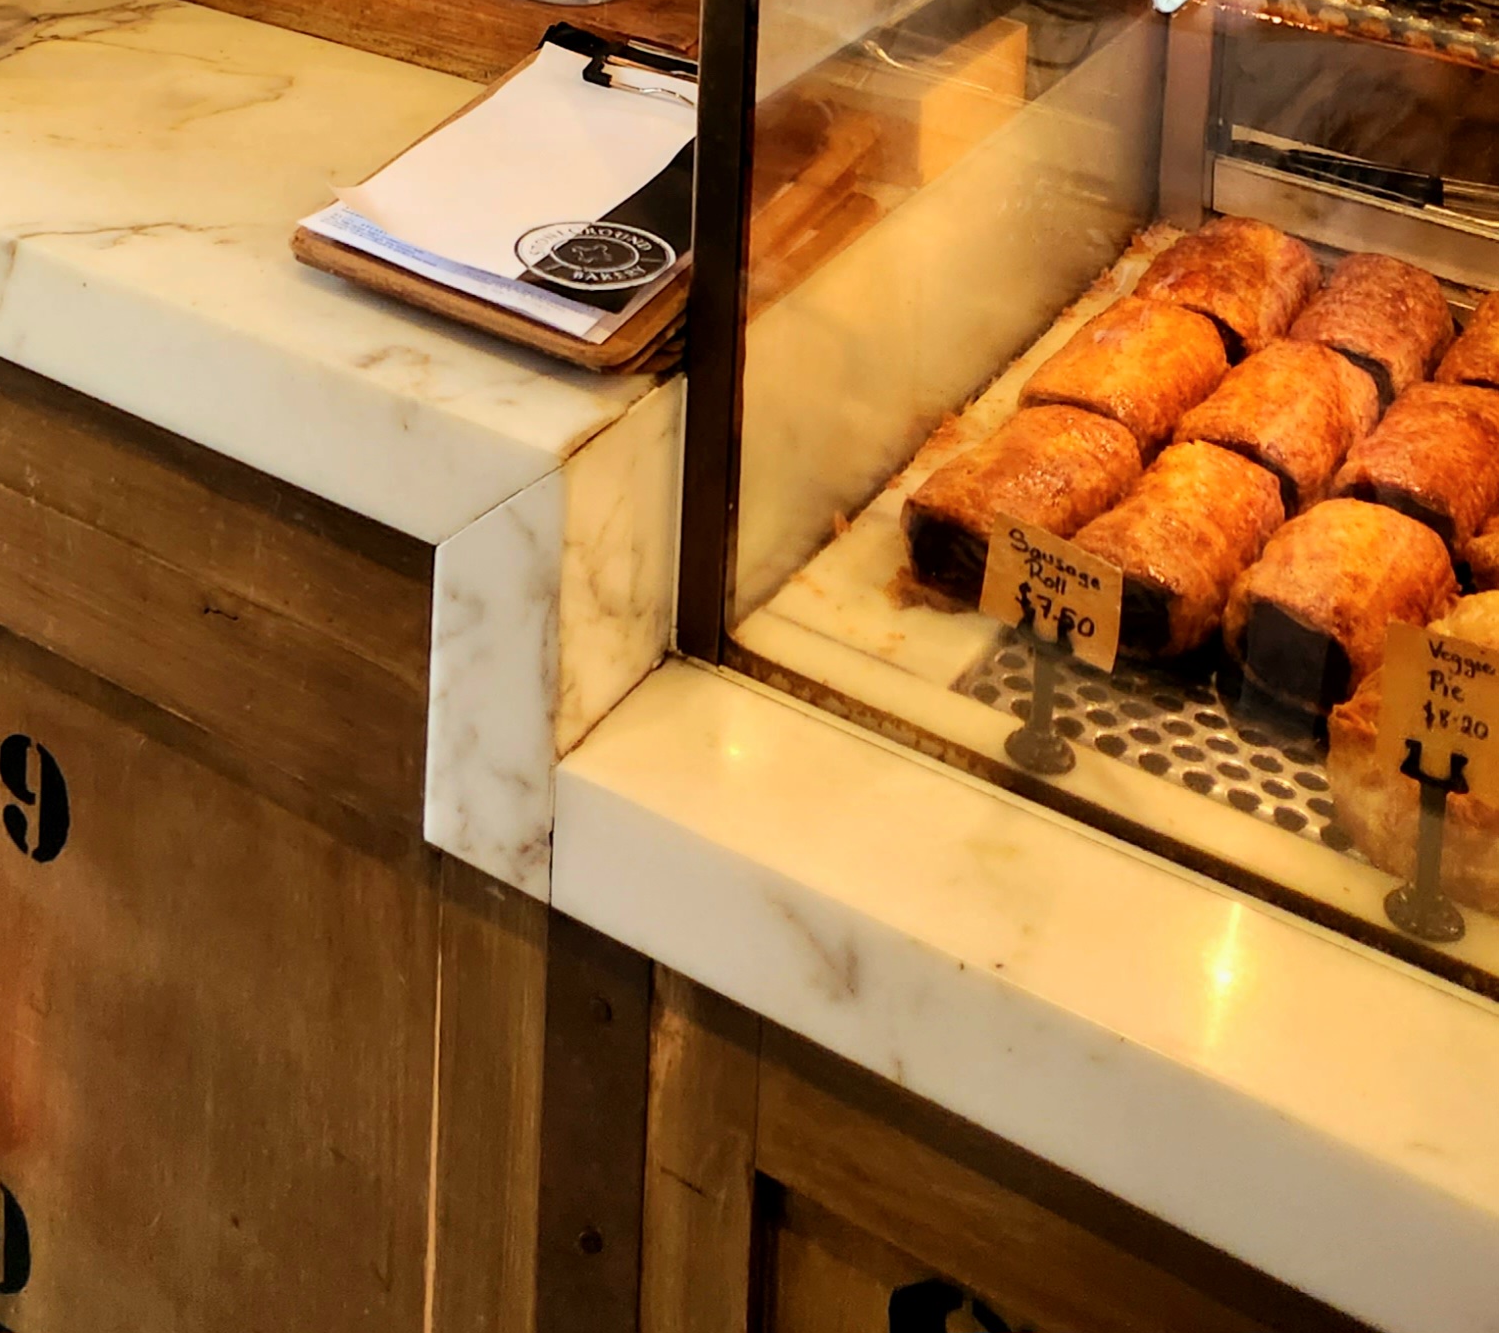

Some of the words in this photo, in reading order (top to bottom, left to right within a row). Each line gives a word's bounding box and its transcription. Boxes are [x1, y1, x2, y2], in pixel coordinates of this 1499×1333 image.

[1008, 527, 1102, 591] Sausage
[1024, 557, 1067, 596] Roll
[1428, 638, 1496, 679] Veggie
[1427, 669, 1465, 703] Pie
